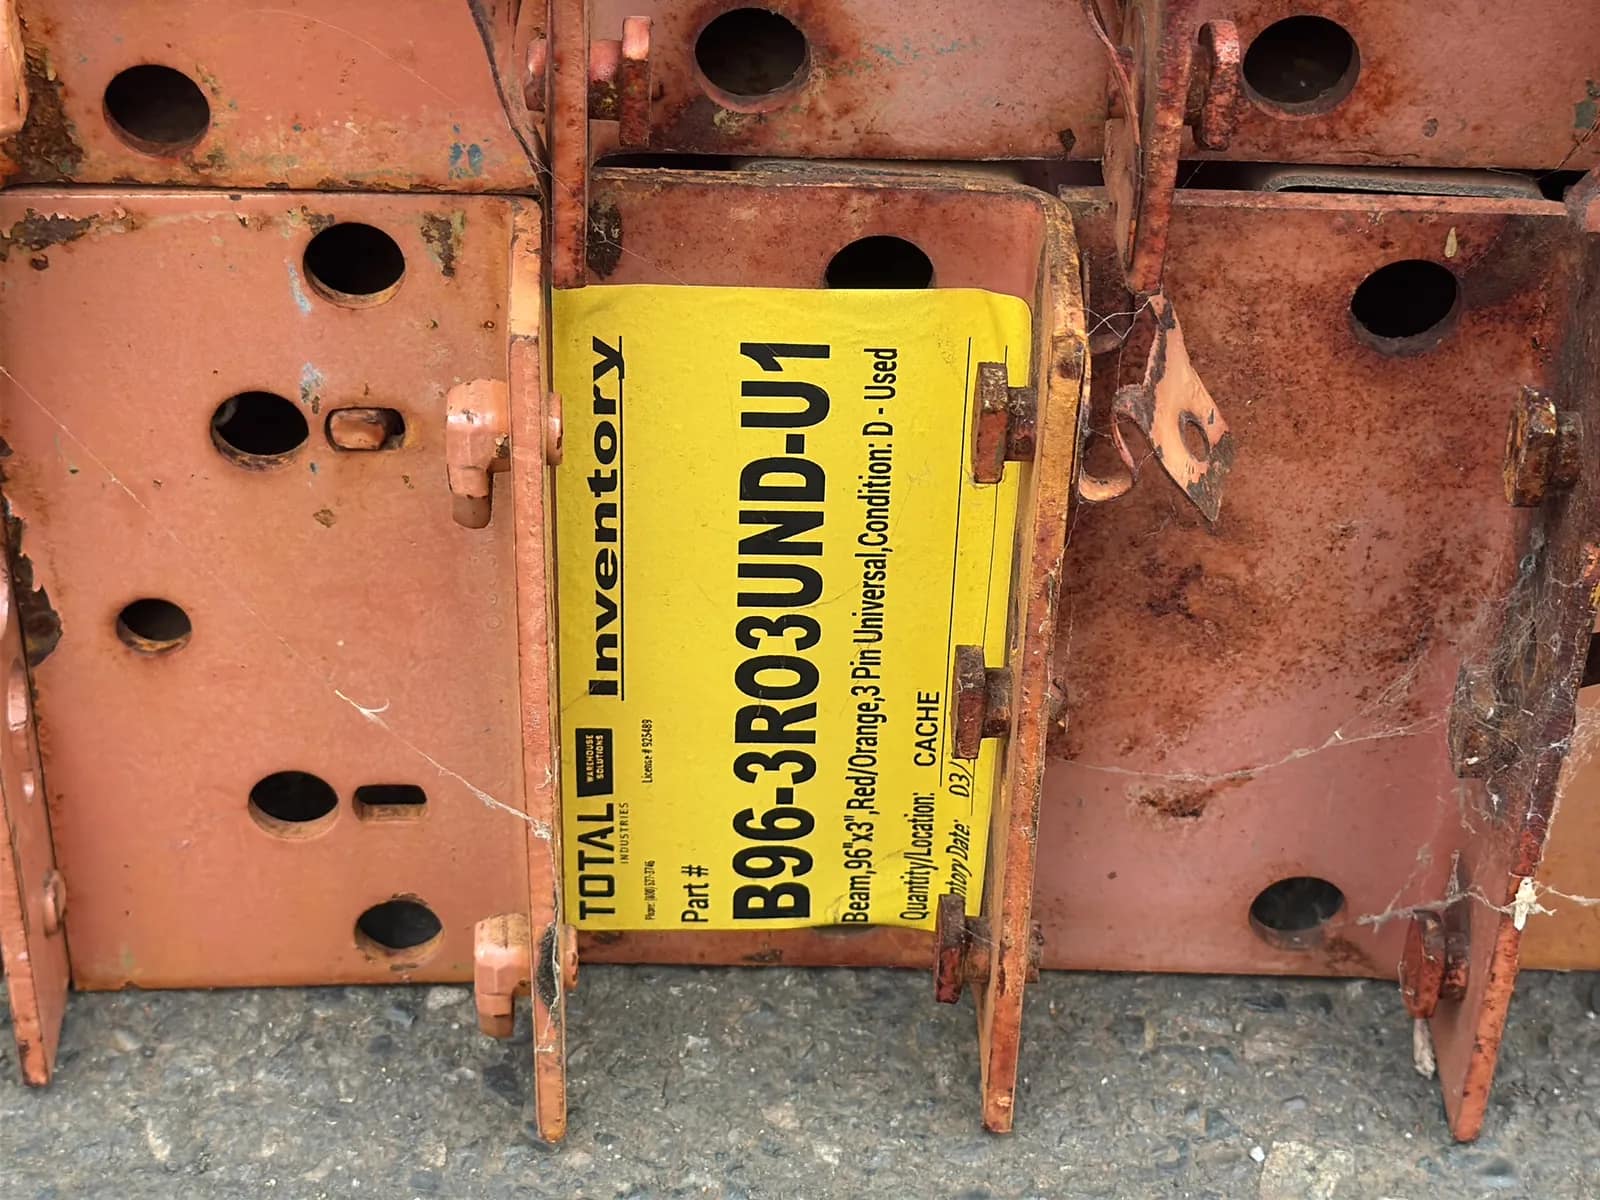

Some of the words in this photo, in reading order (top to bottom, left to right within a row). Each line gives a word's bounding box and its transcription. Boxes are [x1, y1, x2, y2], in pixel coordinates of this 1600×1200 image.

[864, 348, 897, 400] Used
[863, 422, 893, 437] D
[587, 336, 624, 696] Inventory
[852, 443, 893, 643] Universal,Condition:
[849, 649, 882, 679] Pin
[641, 720, 653, 747] 925489
[913, 691, 939, 767] CACHE
[585, 734, 594, 782] WAREHOUSE
[595, 735, 604, 779] SOLUTIONS
[641, 756, 653, 783] License
[619, 802, 629, 864] INDUSTRIES
[946, 820, 969, 860] Date:
[577, 803, 615, 920] TOTAL
[681, 864, 709, 877] #
[899, 792, 938, 920] Quantity/Location:
[944, 861, 971, 894] ntory
[681, 883, 709, 922] Part
